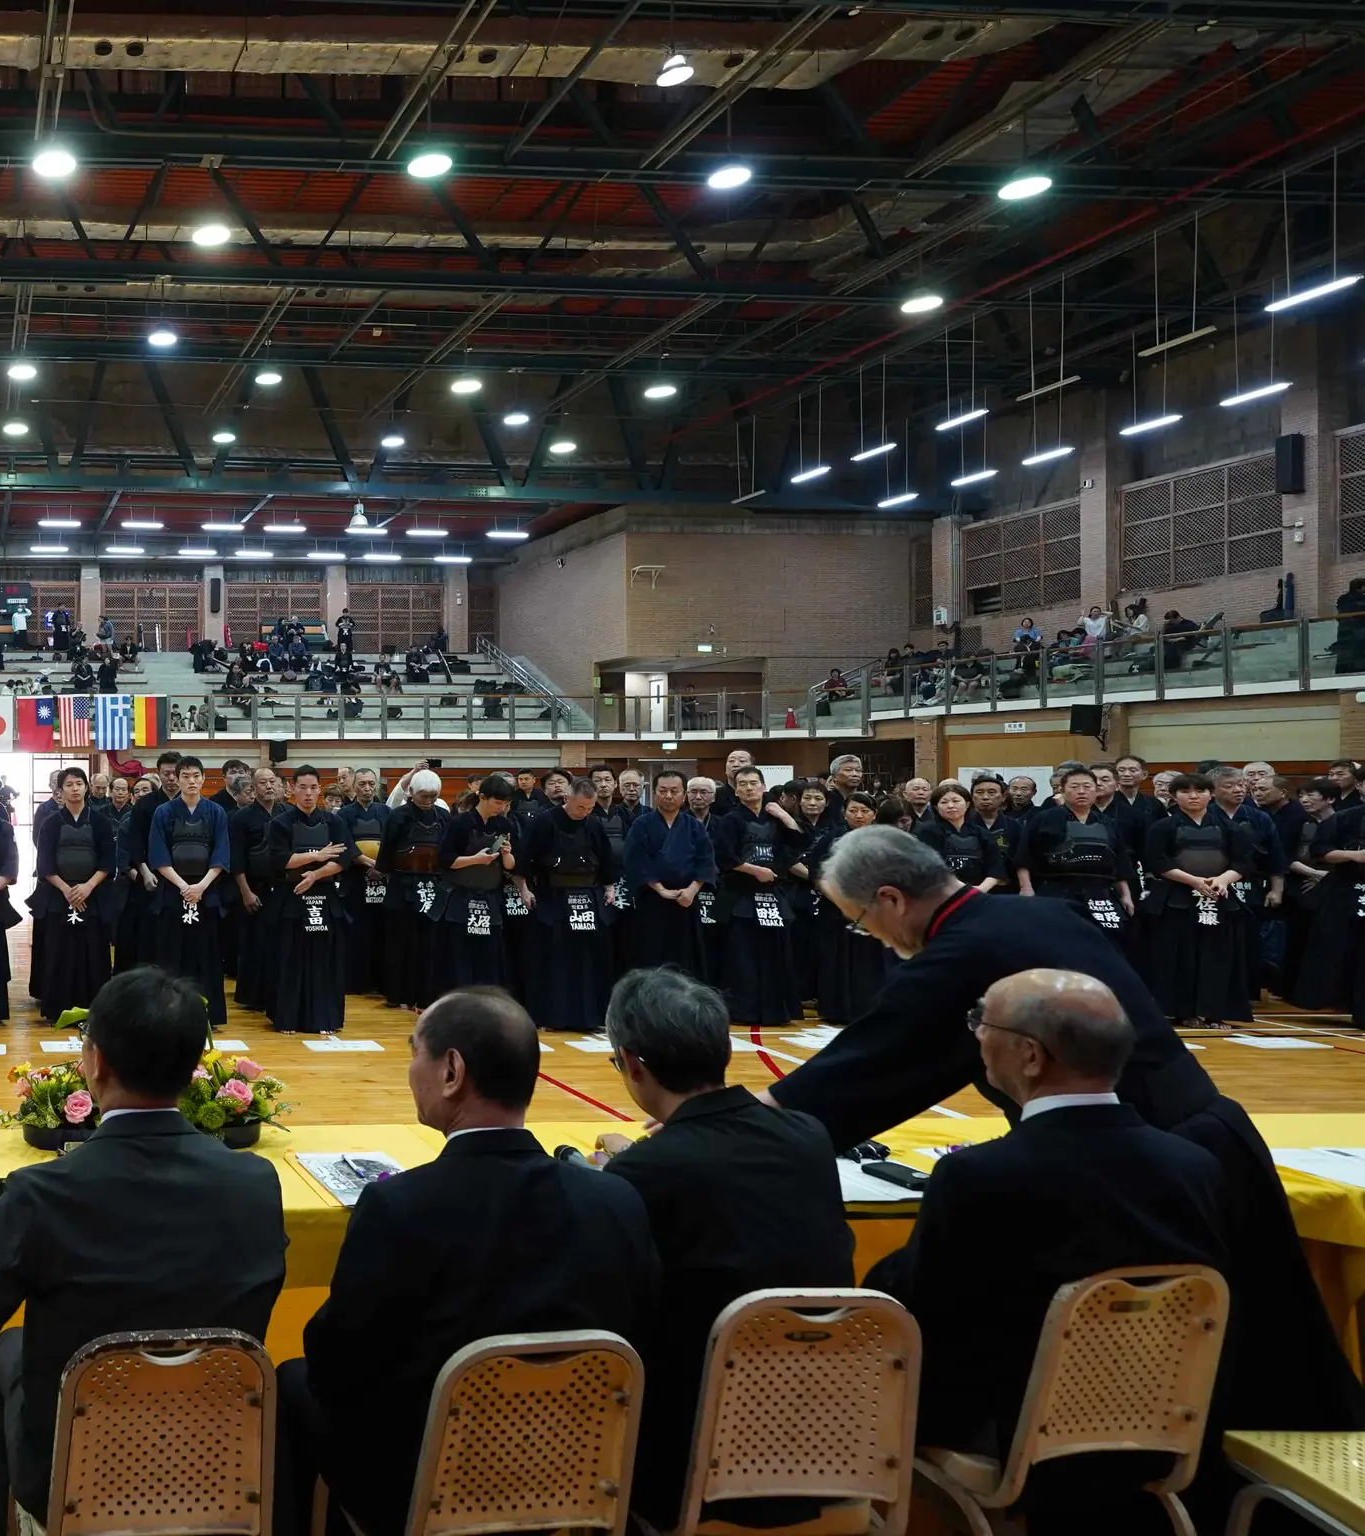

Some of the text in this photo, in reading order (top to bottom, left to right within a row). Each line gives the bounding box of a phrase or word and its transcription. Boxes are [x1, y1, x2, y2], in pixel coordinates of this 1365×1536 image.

[307, 905, 324, 926] 吉田
[569, 909, 596, 923] 山田
[1196, 900, 1221, 926] 佐藤
[569, 922, 596, 931] YAMADA
[758, 918, 785, 928] TASAKA
[467, 927, 491, 935] OONUMA
